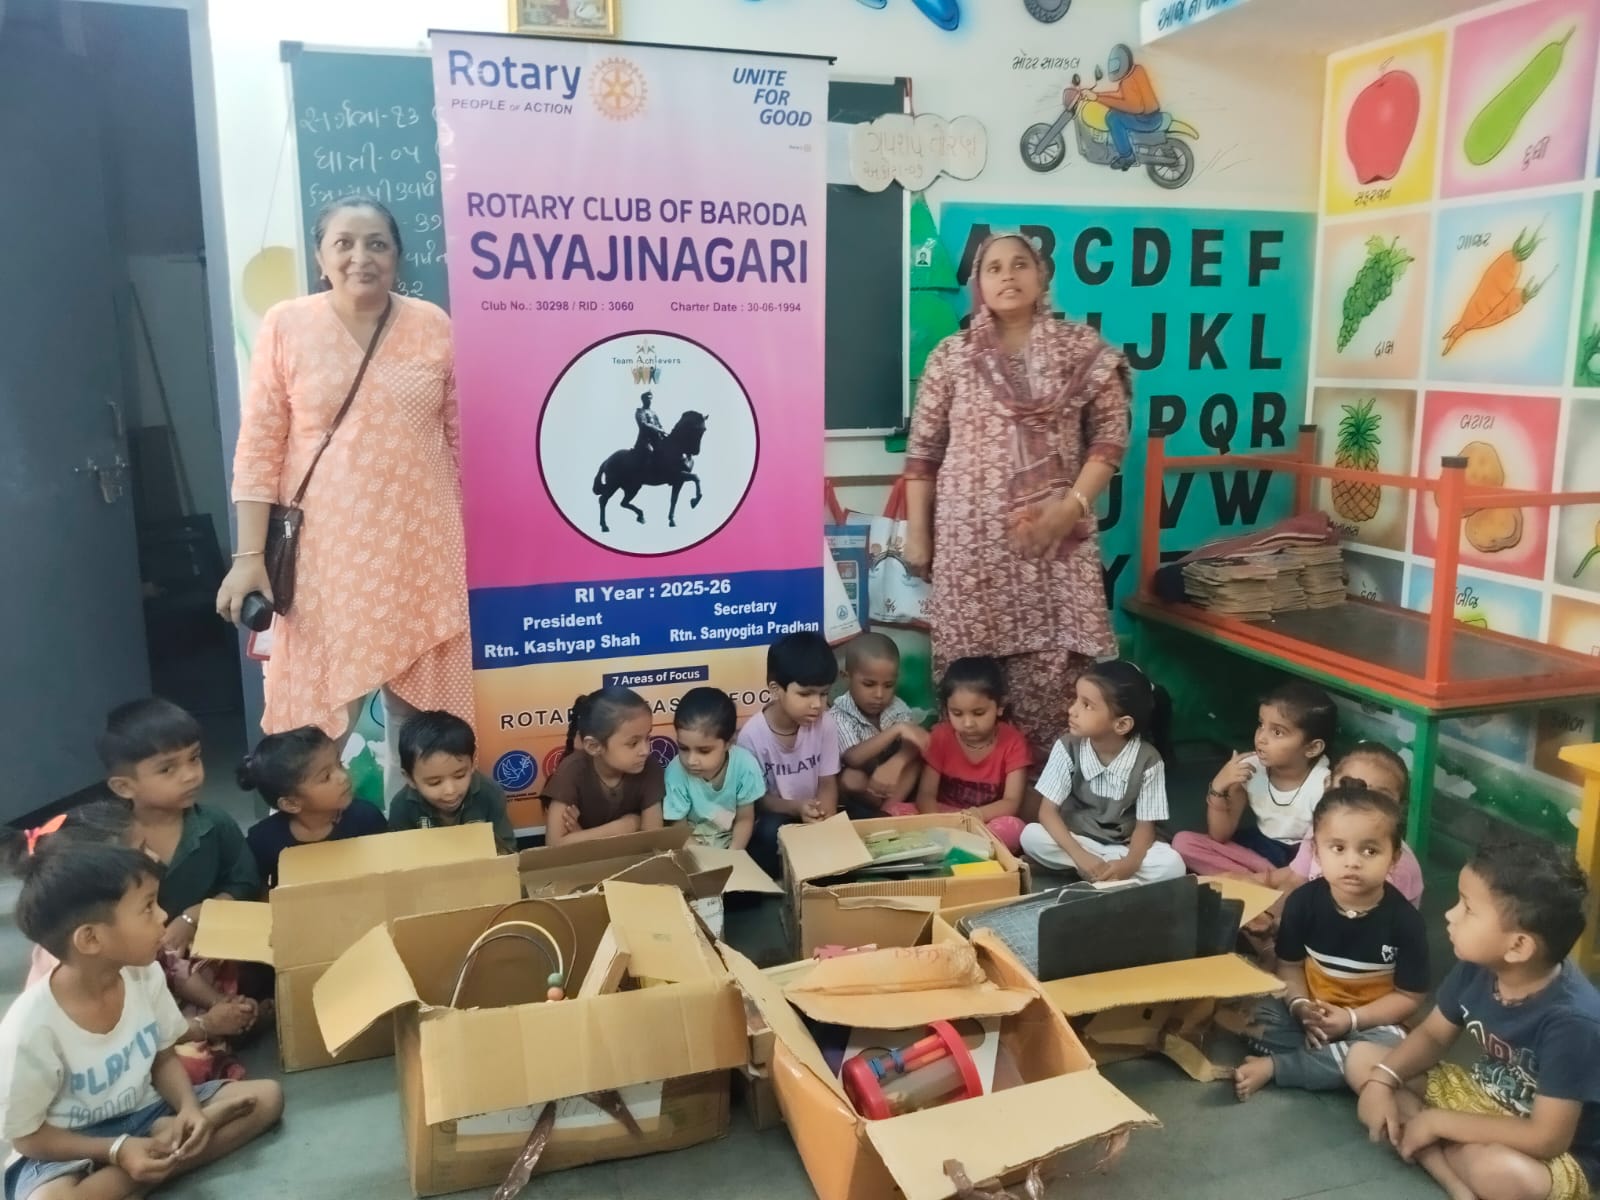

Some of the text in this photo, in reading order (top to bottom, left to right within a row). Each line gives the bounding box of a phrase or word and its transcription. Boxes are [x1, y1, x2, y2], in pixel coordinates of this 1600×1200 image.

[448, 50, 581, 99] Rotary
[732, 67, 787, 86] UNITE
[451, 99, 506, 111] PEOPLE
[524, 102, 573, 115] ACTION
[753, 88, 790, 105] FOR
[760, 108, 812, 126] GOOD
[467, 192, 807, 226] ROTARY CLUB OF BARODA
[470, 231, 808, 284] SAYAJINAGARI
[1073, 227, 1114, 286] C
[1131, 228, 1171, 287] D
[1190, 229, 1224, 287] E
[1248, 231, 1284, 287] F
[481, 301, 507, 311] Club
[536, 301, 569, 311] 30298
[579, 301, 598, 311] RID
[608, 302, 634, 311] 3060
[670, 301, 710, 312] Charter
[713, 302, 737, 312] Date
[747, 302, 801, 312] 30-06-1994
[1123, 312, 1282, 372] J K L
[637, 355, 681, 365] Achievers
[1200, 393, 1238, 455] Q
[1250, 392, 1286, 448] R
[1210, 469, 1273, 526] W
[575, 588, 595, 603] RI
[601, 586, 645, 601] Year
[660, 579, 731, 598] 2025-26
[714, 601, 777, 616] Secretary
[523, 612, 603, 631] President
[670, 628, 697, 642] Rtn.
[700, 624, 763, 641] Sanyogita
[767, 620, 819, 634] Pradhan
[485, 632, 641, 658] Rtn. Kashyap Shah
[612, 669, 701, 686] 7 Areas of Focus
